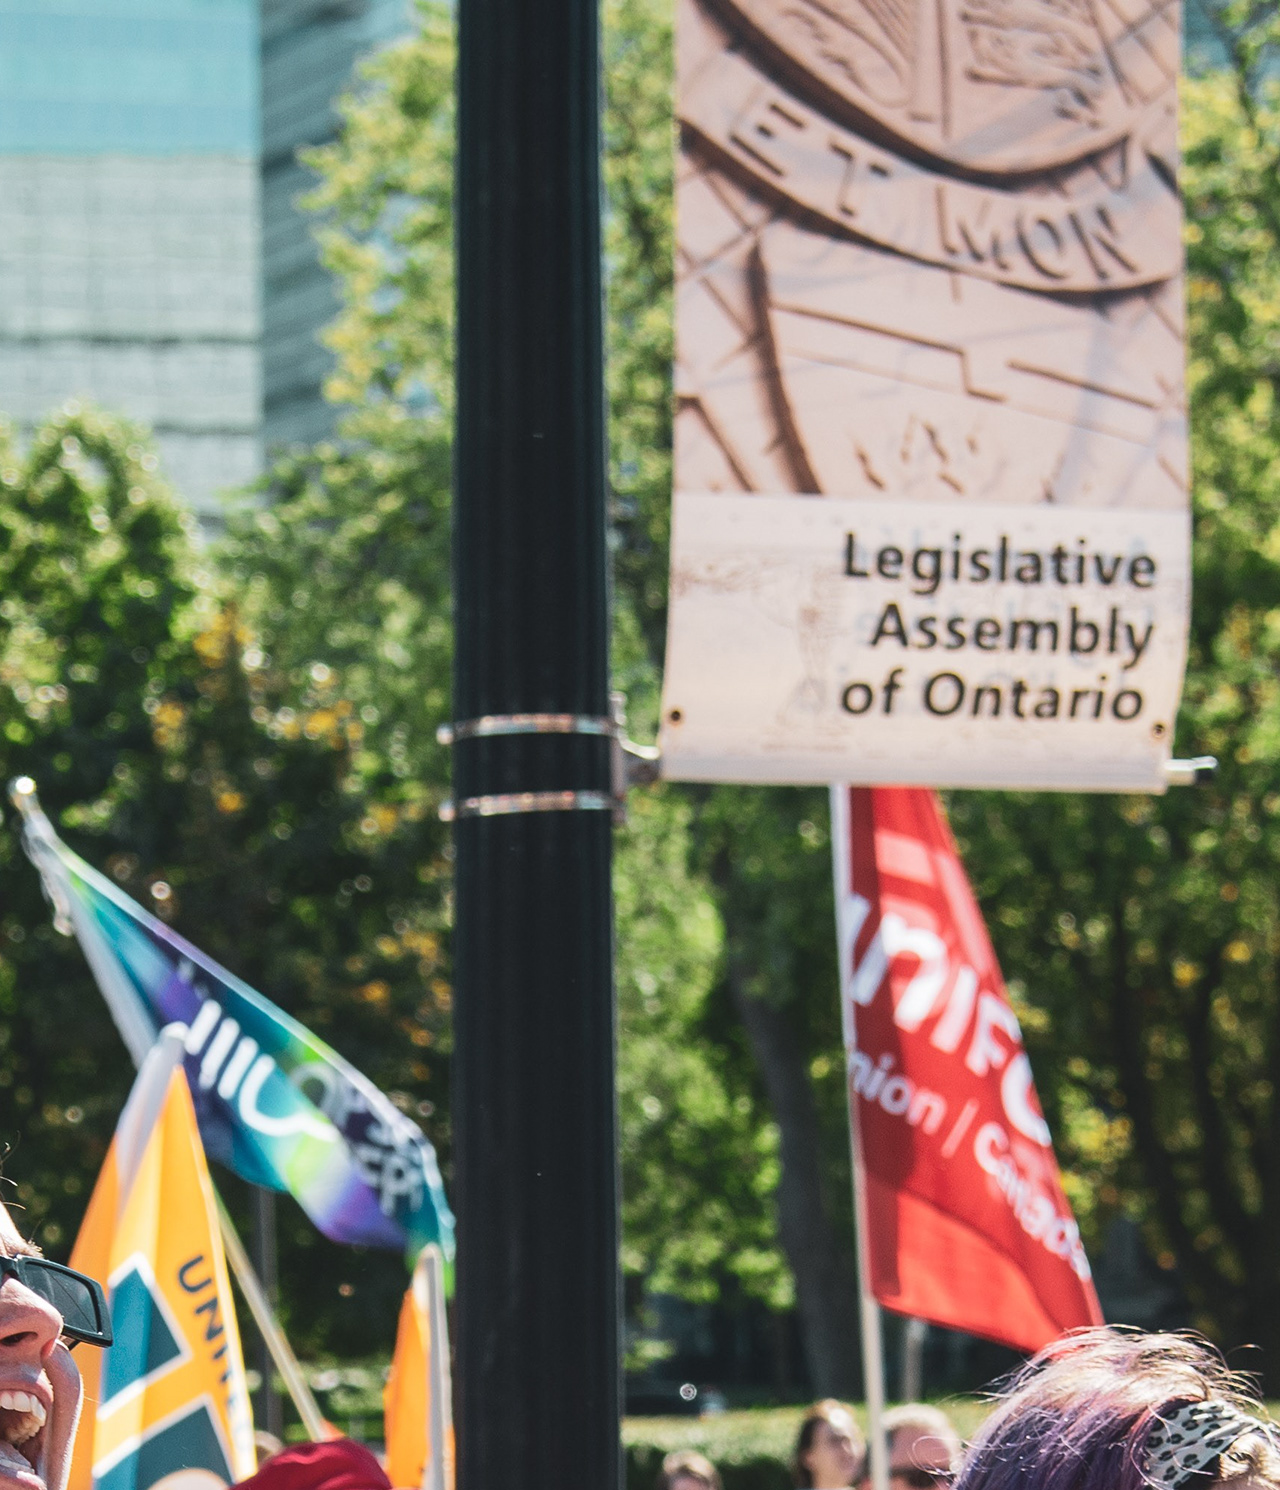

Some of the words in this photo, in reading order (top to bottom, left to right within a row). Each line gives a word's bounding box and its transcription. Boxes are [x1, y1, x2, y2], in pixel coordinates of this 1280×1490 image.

[843, 531, 1157, 597] Legislative
[870, 602, 1154, 671] Assembly
[840, 667, 905, 716] of
[923, 671, 1144, 722] Ontario
